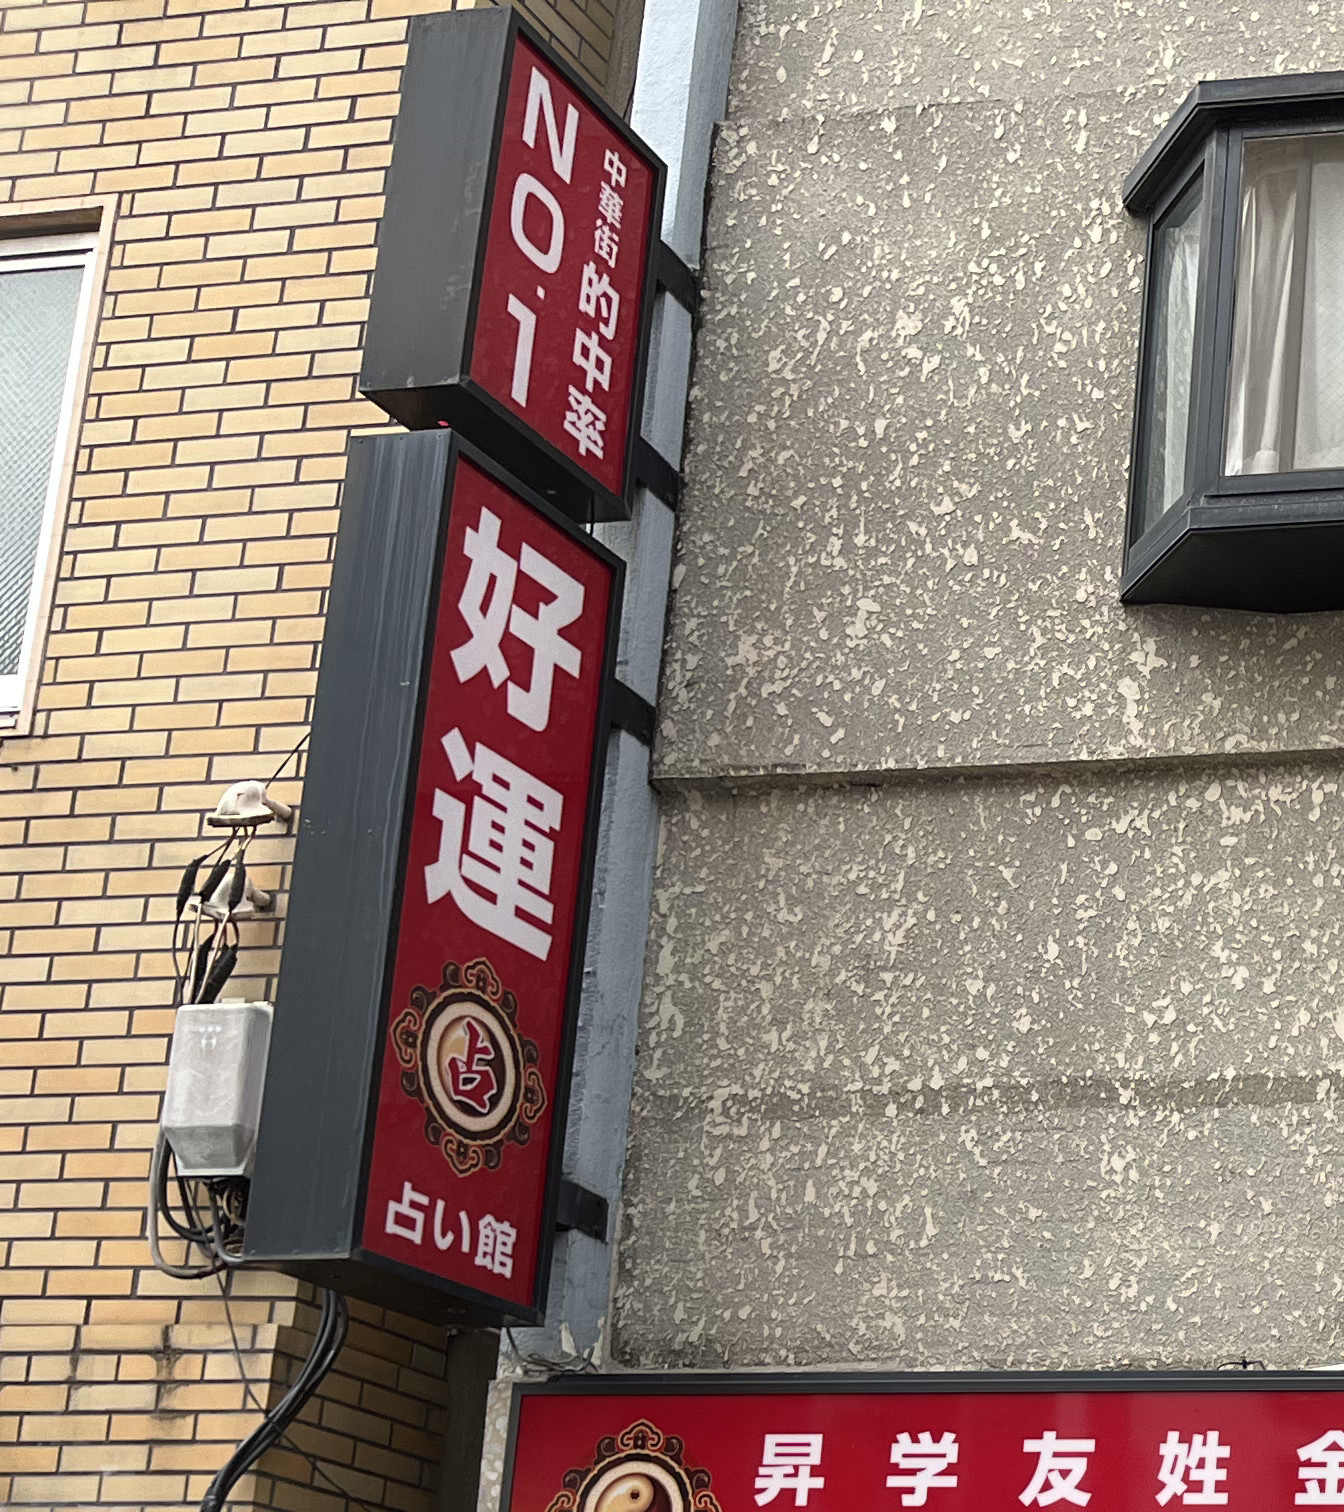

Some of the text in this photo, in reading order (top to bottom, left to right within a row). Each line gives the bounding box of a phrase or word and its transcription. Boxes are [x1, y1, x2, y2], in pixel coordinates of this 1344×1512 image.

[508, 65, 579, 408] NO.1
[563, 149, 627, 461] 中華街的中率
[424, 505, 586, 962] 好運
[445, 1016, 499, 1115] 占
[384, 1181, 518, 1280] 占い館
